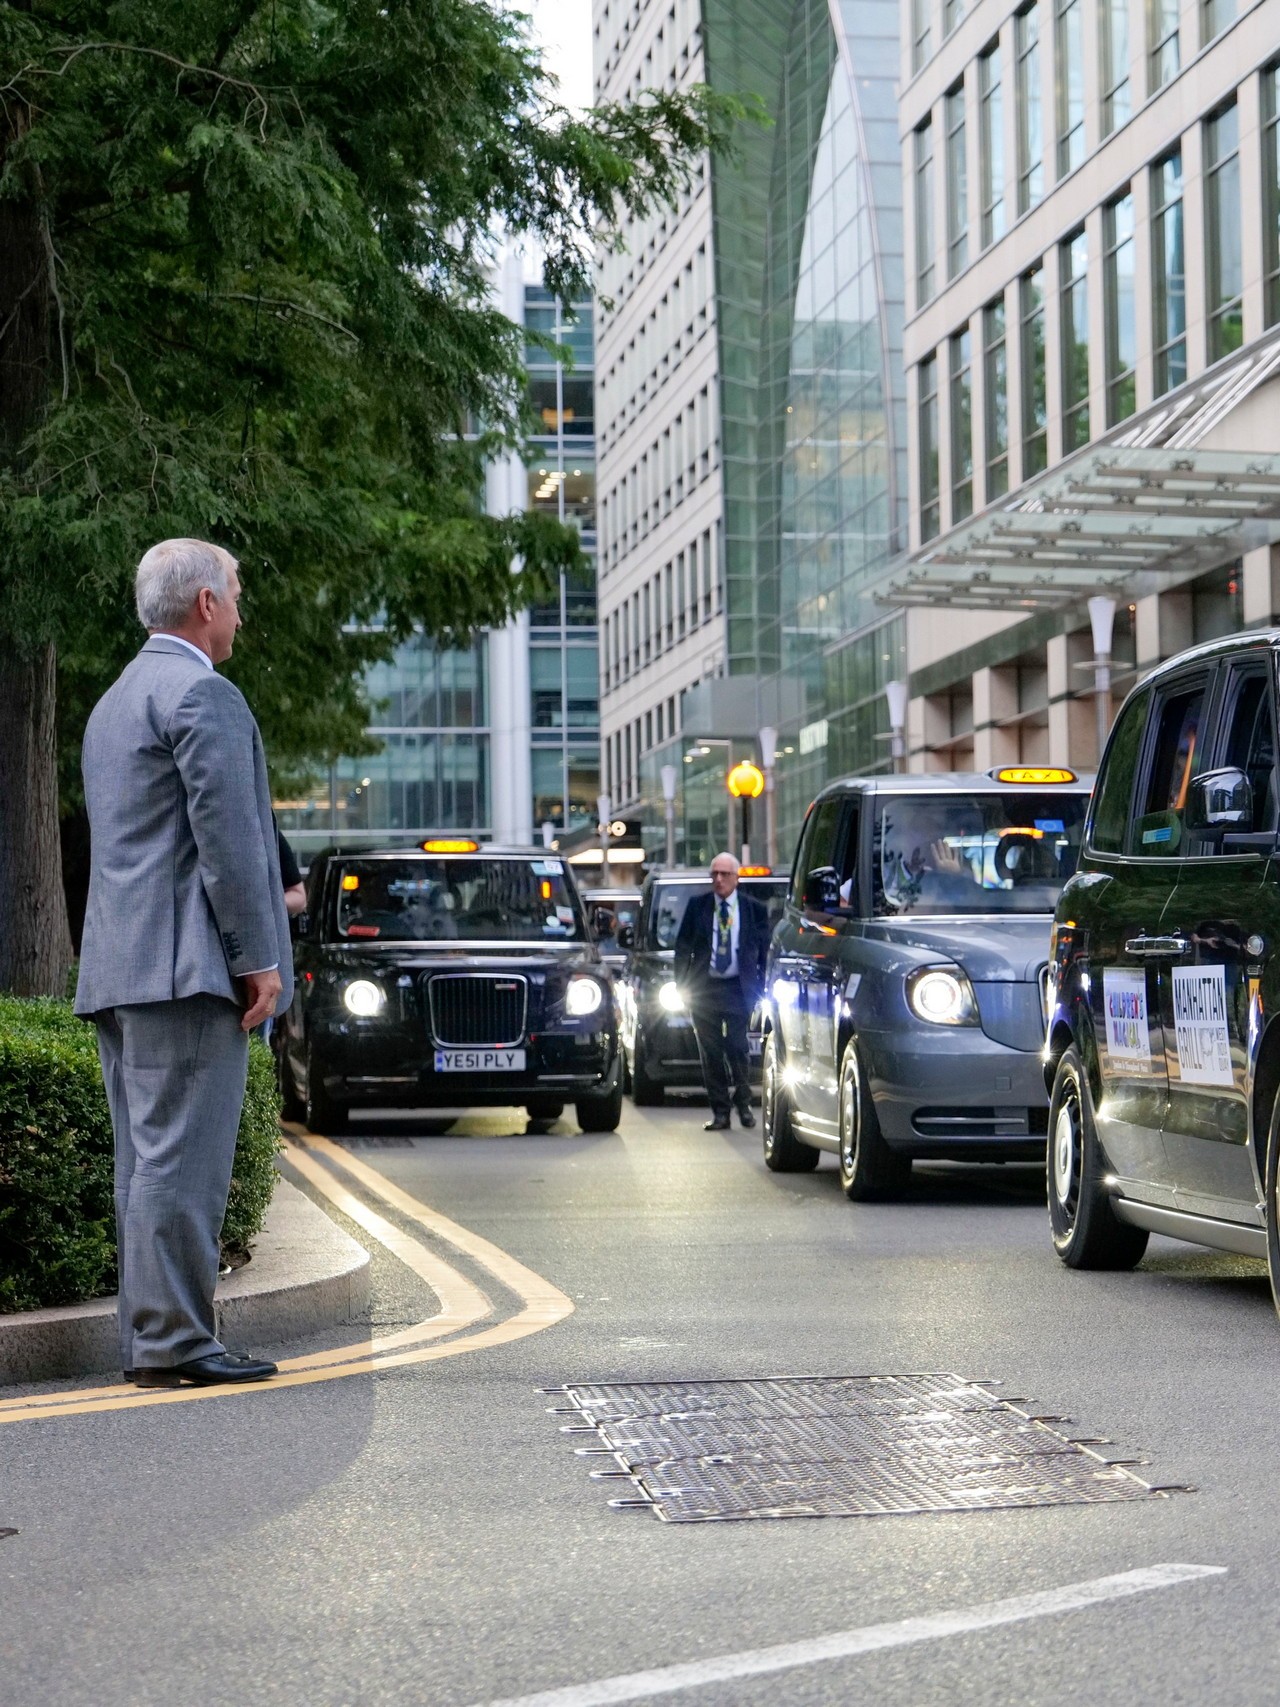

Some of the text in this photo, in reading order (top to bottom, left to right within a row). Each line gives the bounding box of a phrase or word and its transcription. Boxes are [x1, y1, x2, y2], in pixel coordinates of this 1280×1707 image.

[1007, 770, 1066, 780] TAXI
[1174, 977, 1225, 1021] MANHATTAN
[484, 1053, 515, 1068] PLY
[1177, 1026, 1203, 1070] GRILL
